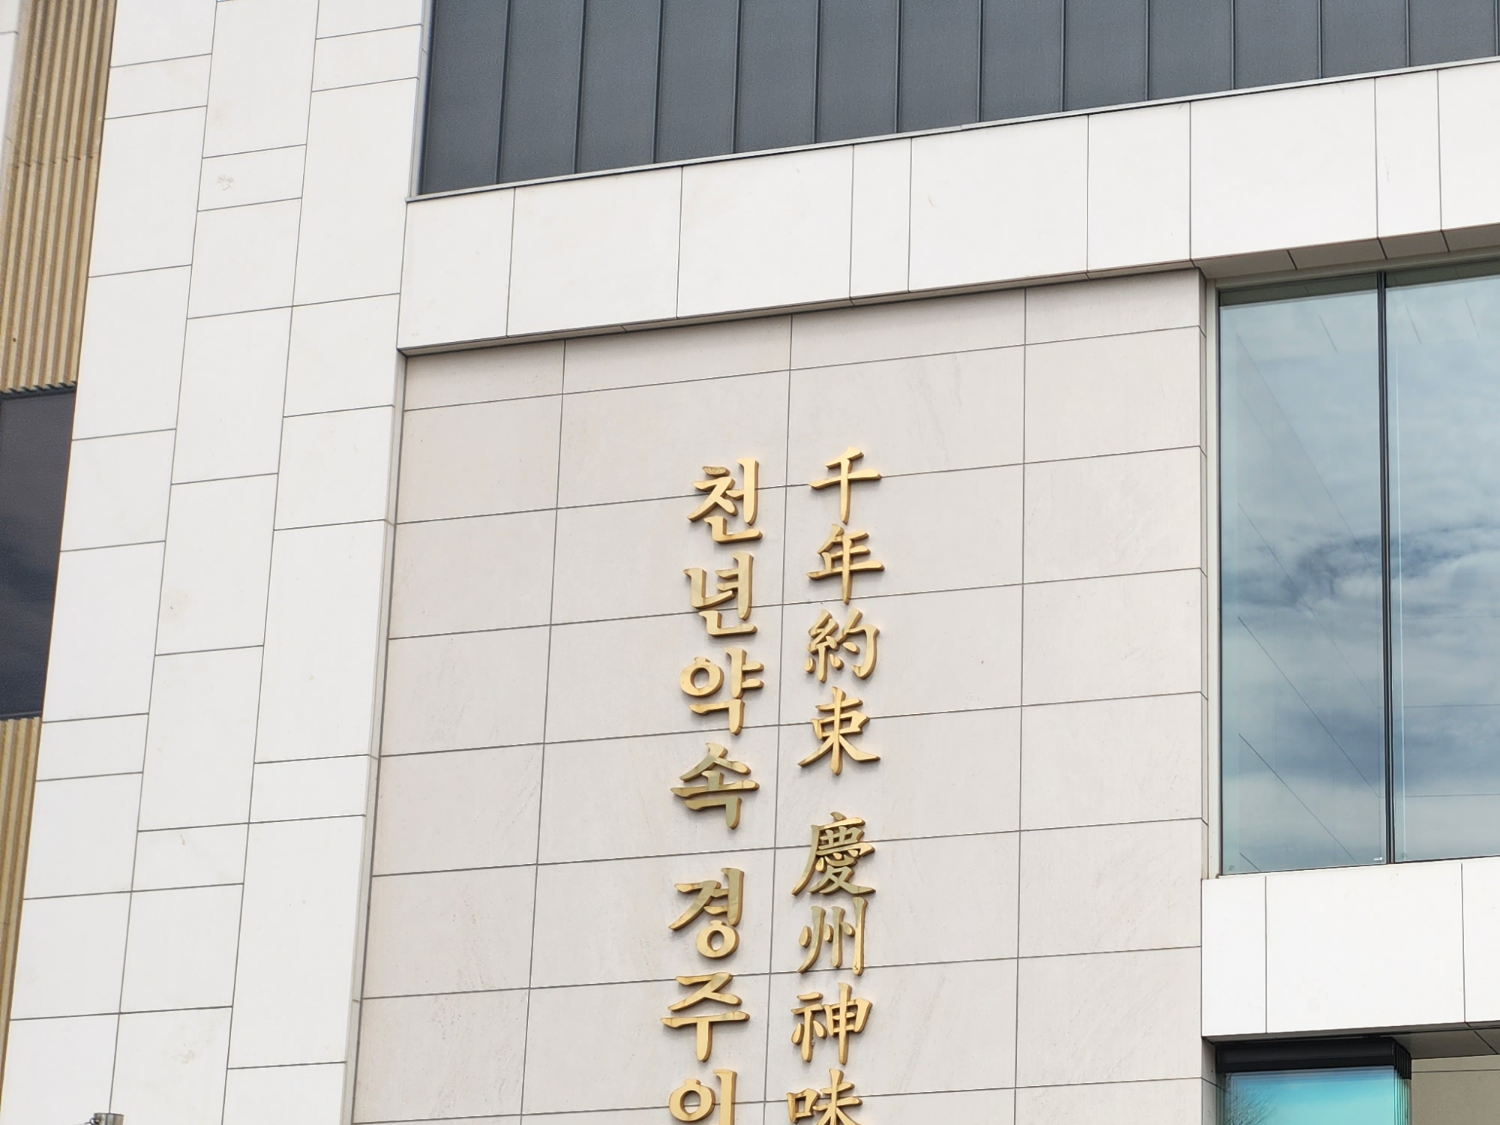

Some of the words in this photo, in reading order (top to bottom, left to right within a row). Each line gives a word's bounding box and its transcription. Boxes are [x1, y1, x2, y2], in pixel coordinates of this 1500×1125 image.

[669, 457, 765, 830] 천년약속
[797, 446, 885, 776] 千年約束
